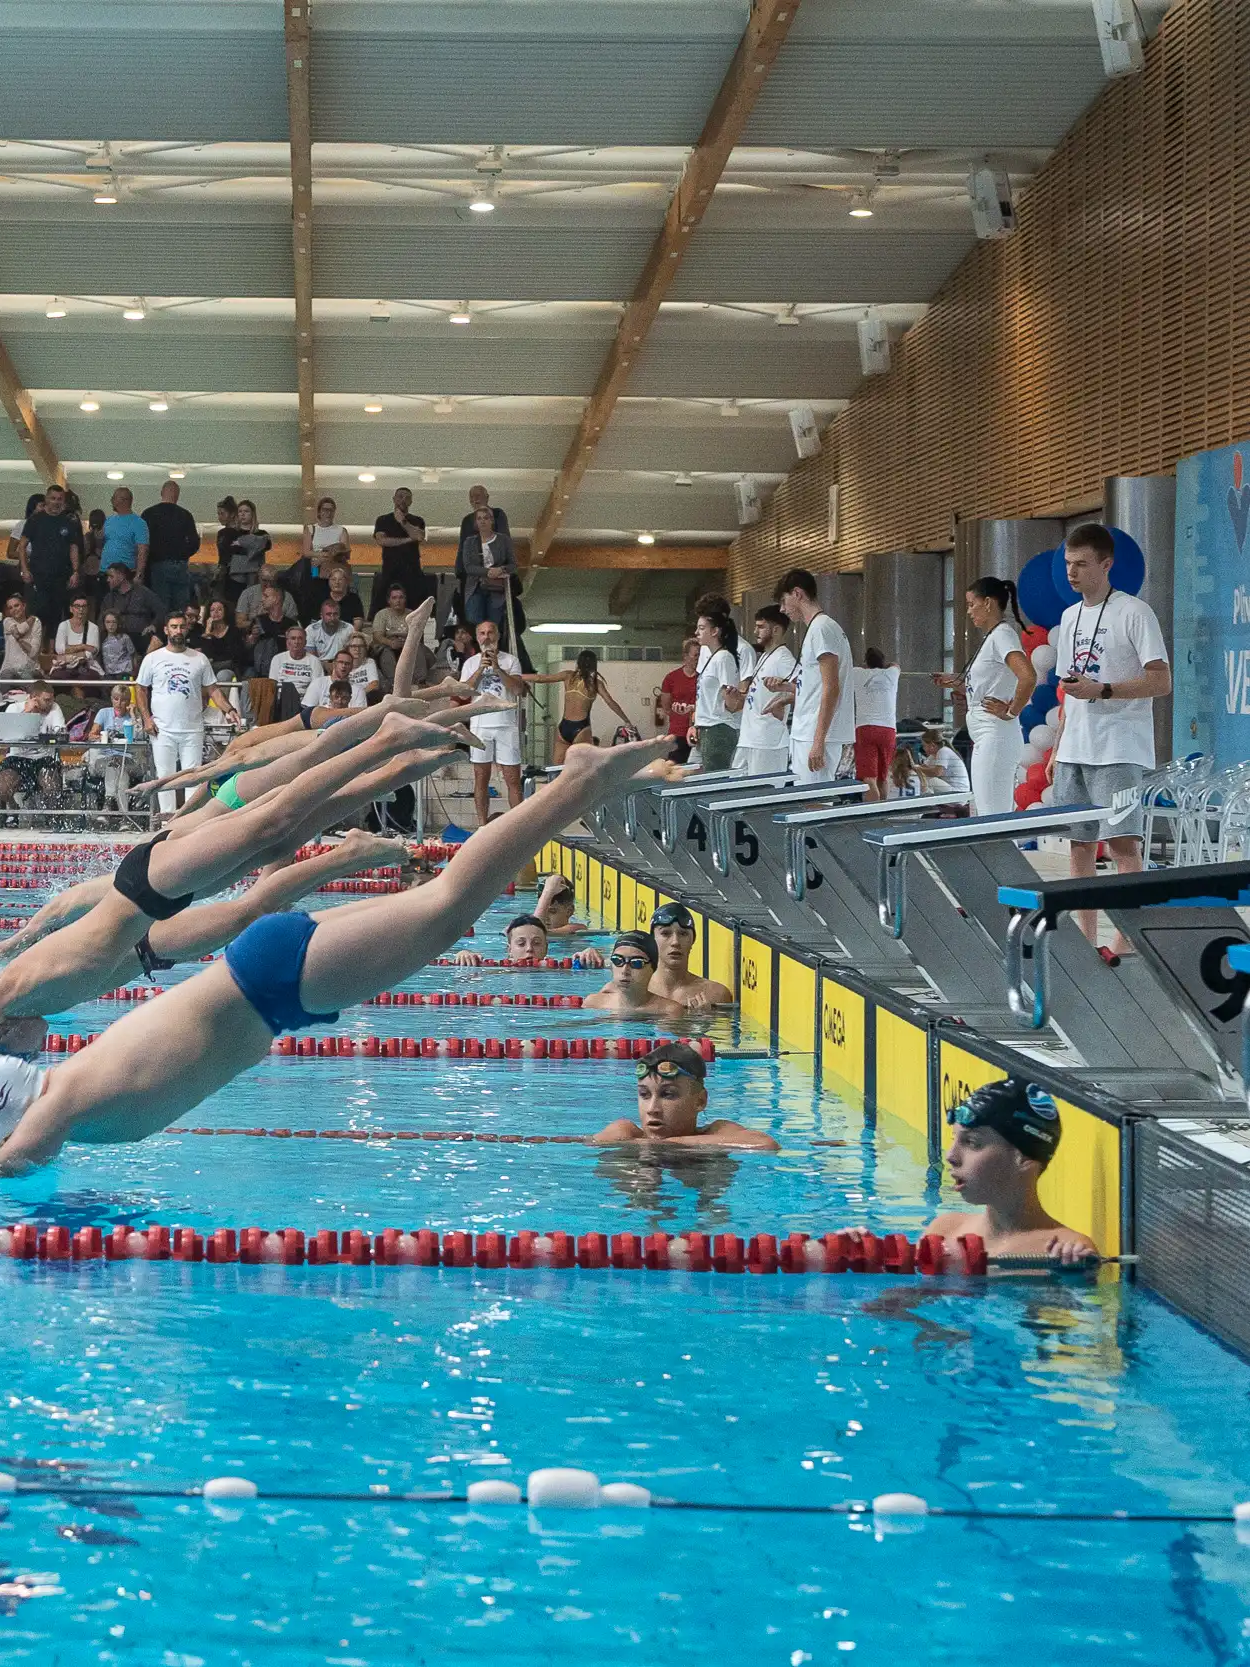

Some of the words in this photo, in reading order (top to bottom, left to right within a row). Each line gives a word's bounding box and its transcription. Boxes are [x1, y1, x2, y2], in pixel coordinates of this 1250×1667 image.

[686, 814, 707, 852] 4
[734, 820, 759, 866] 5
[1200, 936, 1250, 1023] 9
[823, 1003, 846, 1050] OMEGA
